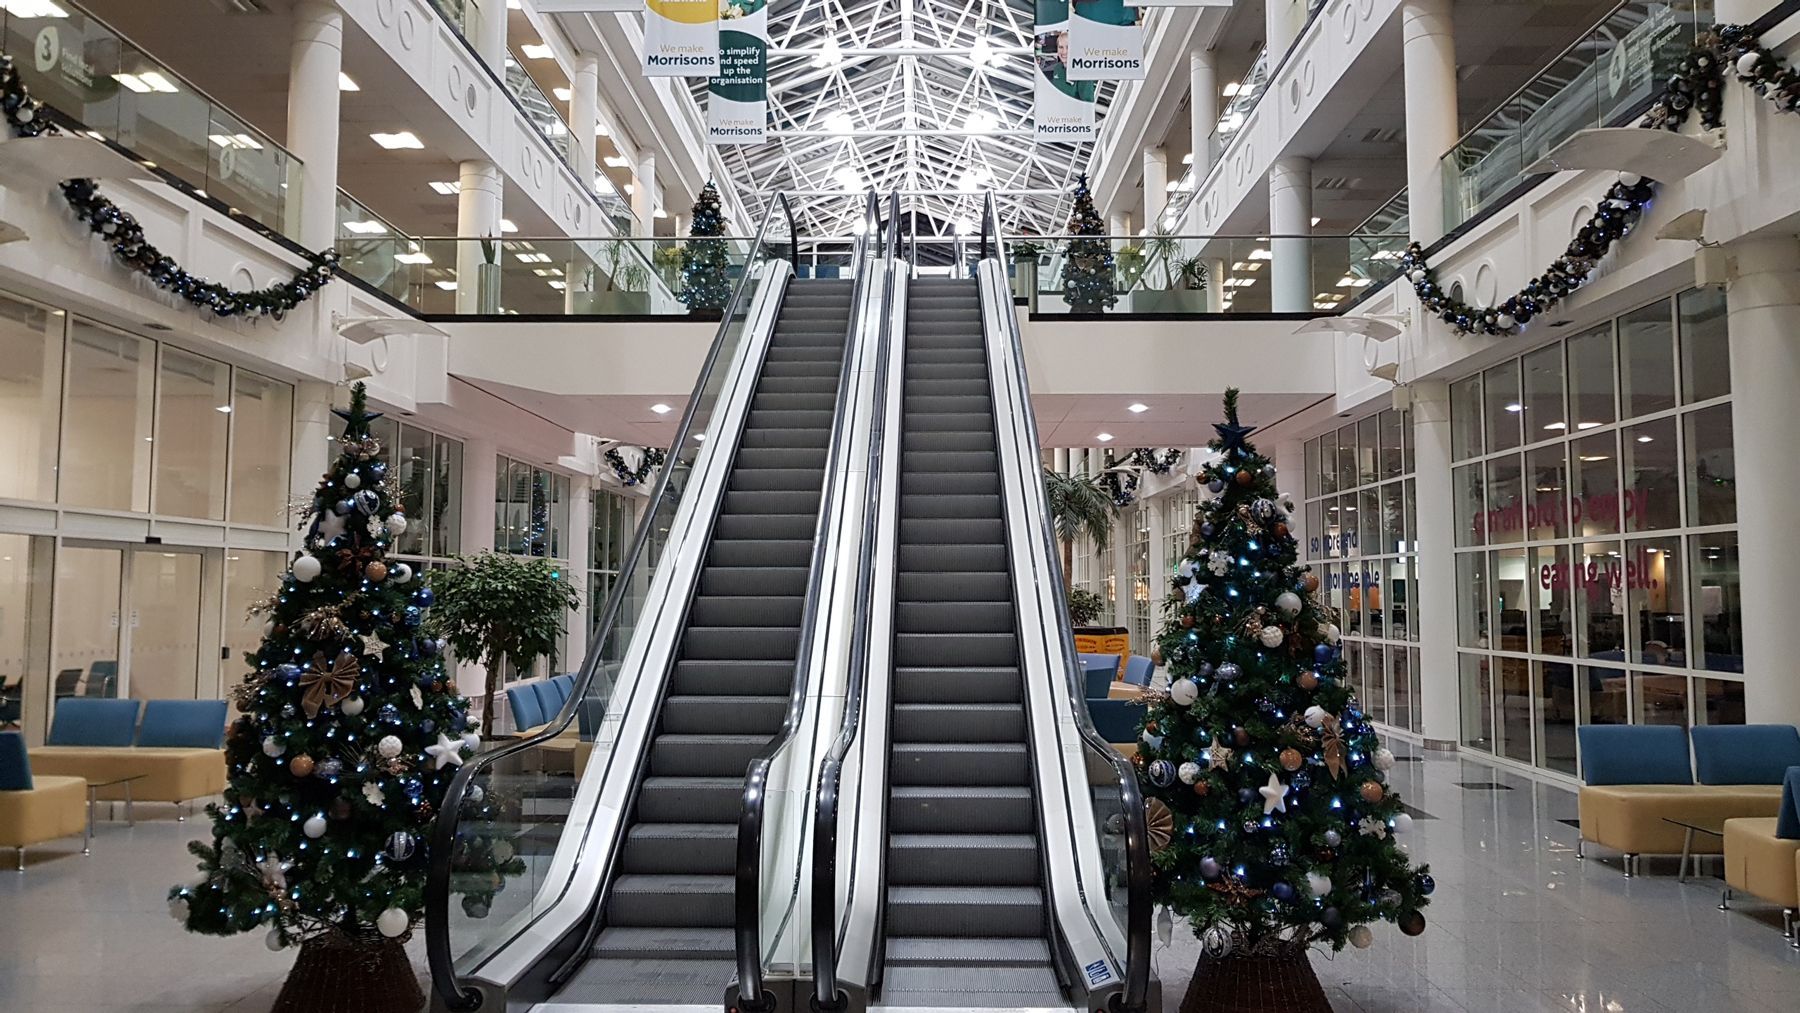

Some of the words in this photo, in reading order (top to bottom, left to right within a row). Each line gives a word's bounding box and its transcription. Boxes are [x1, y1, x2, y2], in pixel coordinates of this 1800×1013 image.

[42, 34, 51, 61] 3
[660, 44, 676, 53] We
[678, 44, 704, 53] make
[1084, 47, 1099, 56] We
[1102, 47, 1128, 56] make
[726, 47, 760, 60] simplify
[647, 54, 715, 66] Morrisons
[720, 57, 732, 65] nd
[733, 57, 759, 66] speed
[1071, 57, 1140, 69] Morrisons
[723, 68, 734, 76] up
[737, 66, 751, 75] the
[711, 76, 763, 86] organisation
[710, 127, 762, 136] Morrisons
[1038, 124, 1091, 133] Morrisons
